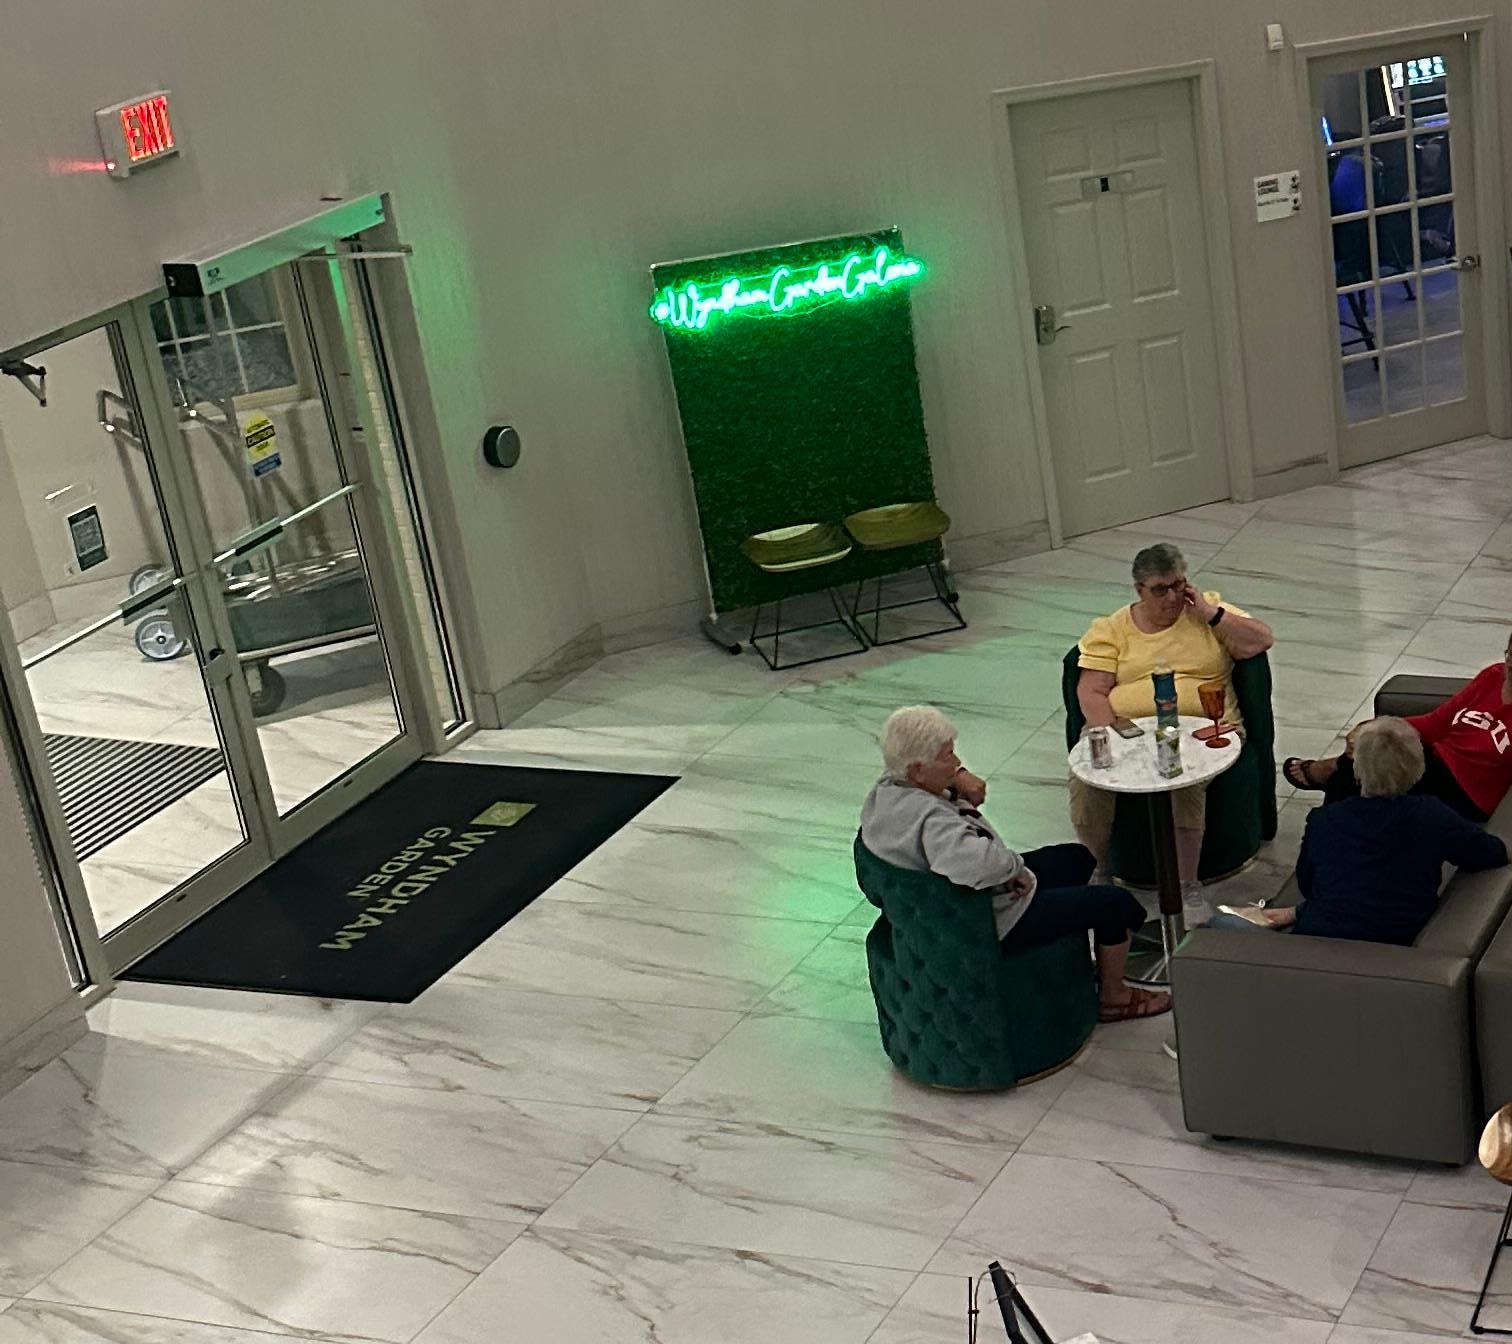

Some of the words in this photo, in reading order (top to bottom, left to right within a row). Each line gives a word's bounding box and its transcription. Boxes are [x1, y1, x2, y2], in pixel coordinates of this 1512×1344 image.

[121, 96, 174, 162] EXIT
[318, 829, 497, 951] WYNDHAM
[346, 826, 452, 898] GARDEN
